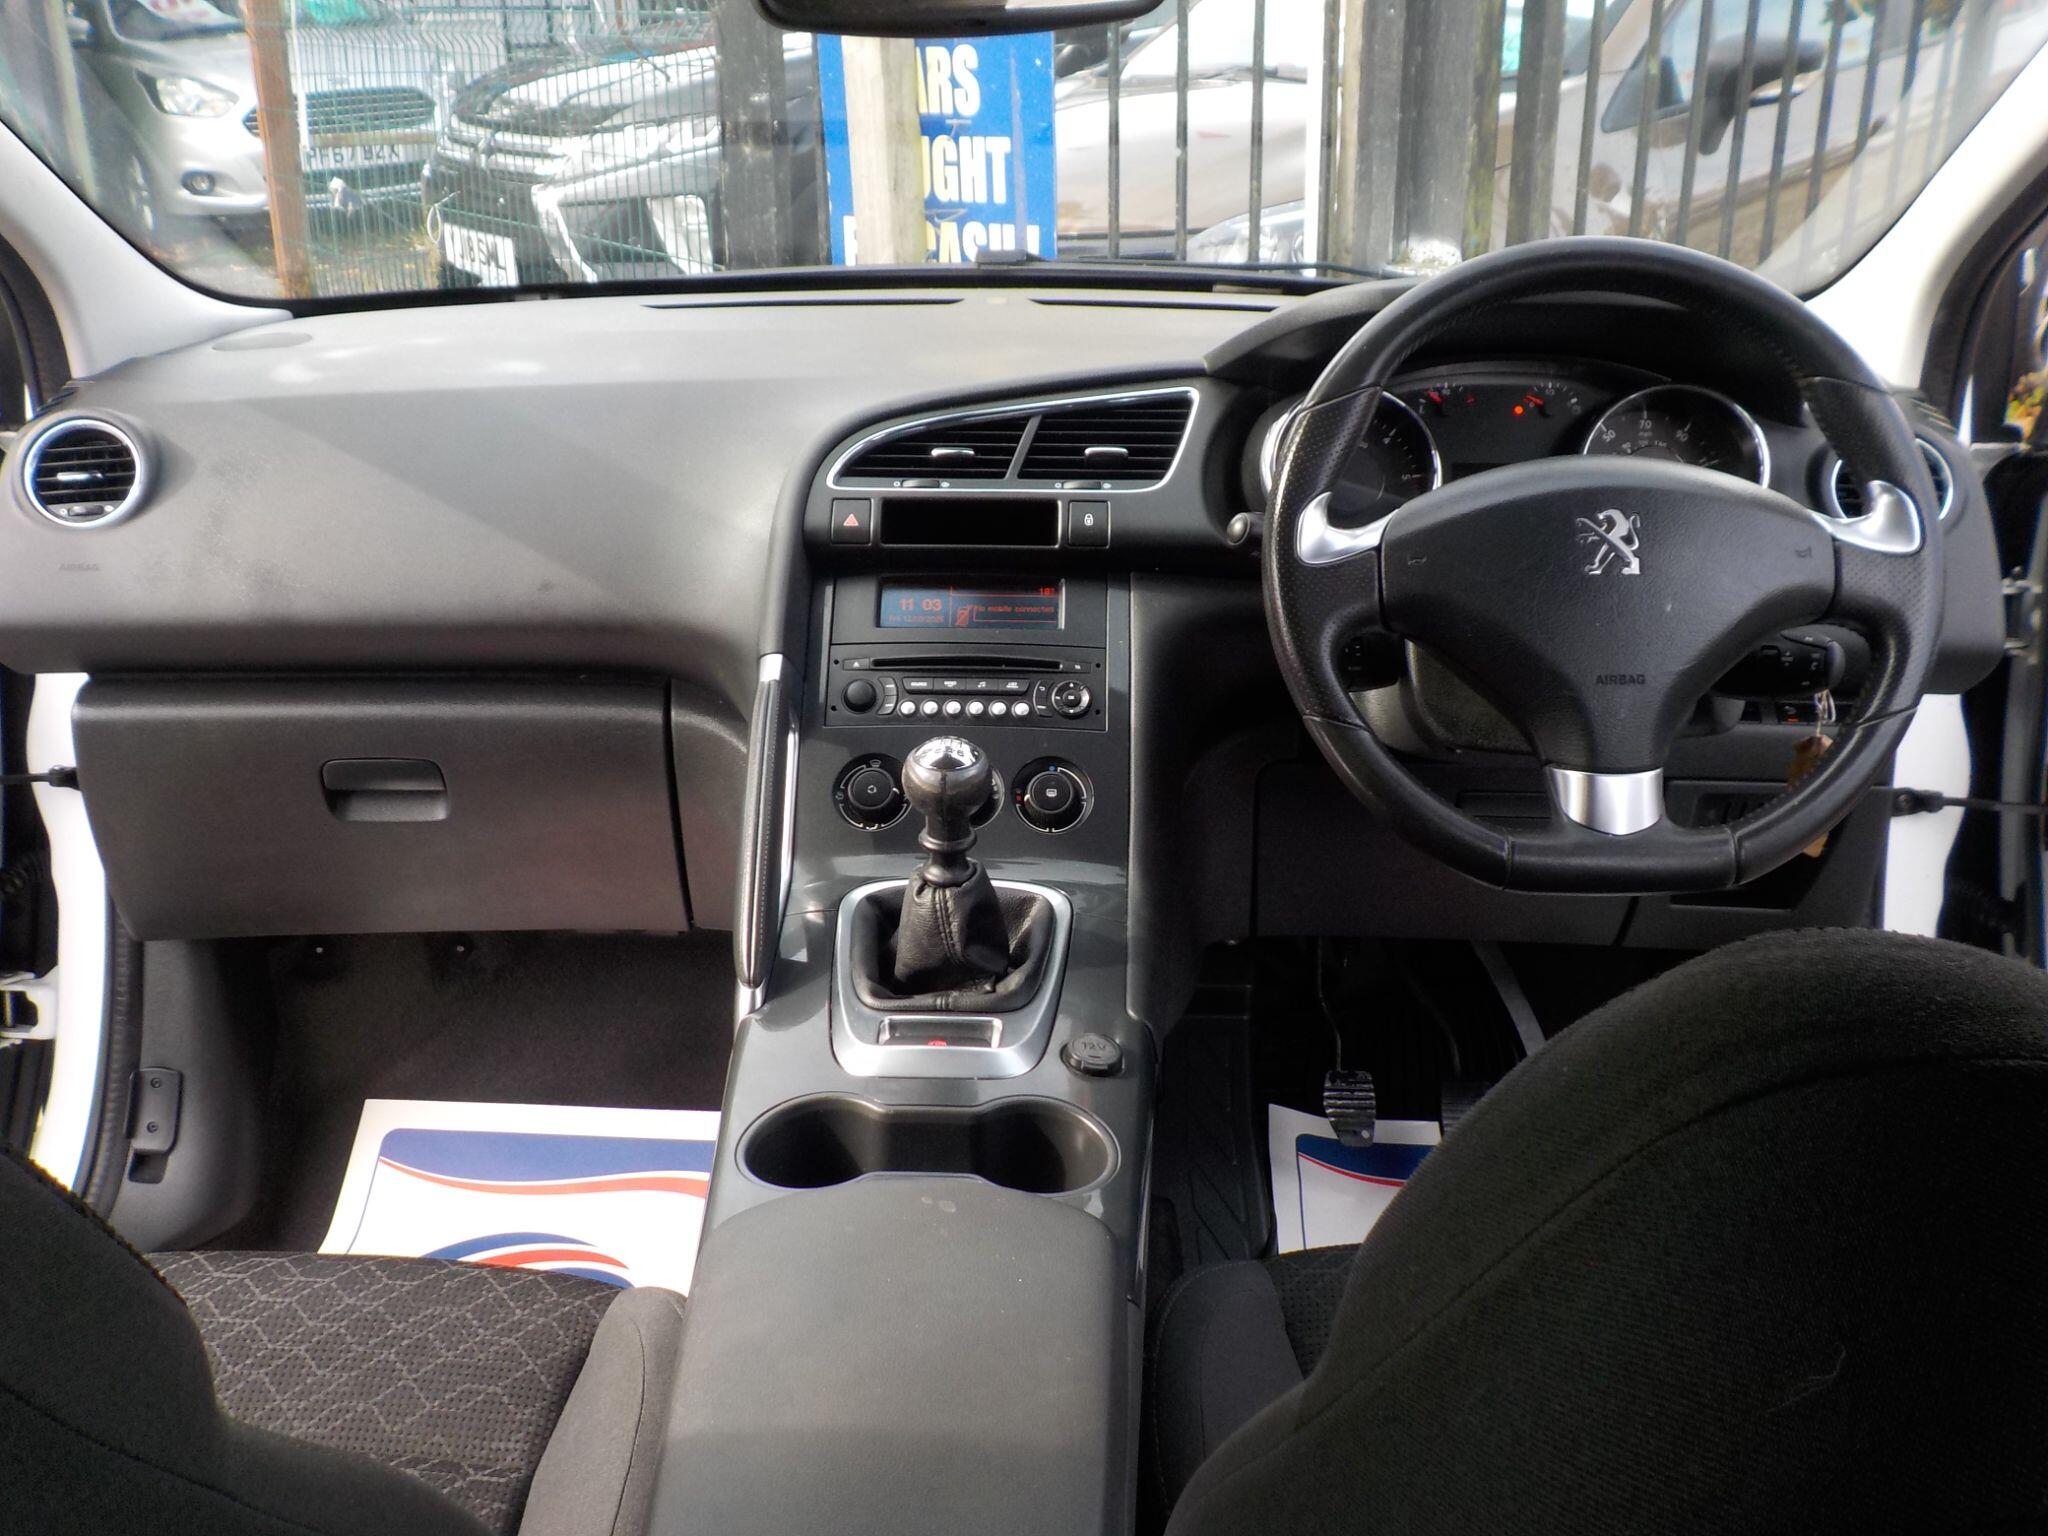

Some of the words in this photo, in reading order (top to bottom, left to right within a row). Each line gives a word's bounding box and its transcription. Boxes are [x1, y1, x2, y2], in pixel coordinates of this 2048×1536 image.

[1639, 420, 1653, 430] 70
[1602, 429, 1617, 443] 50
[901, 599, 915, 611] 11
[921, 599, 943, 611] 03
[1595, 673, 1646, 685] AIRBAG
